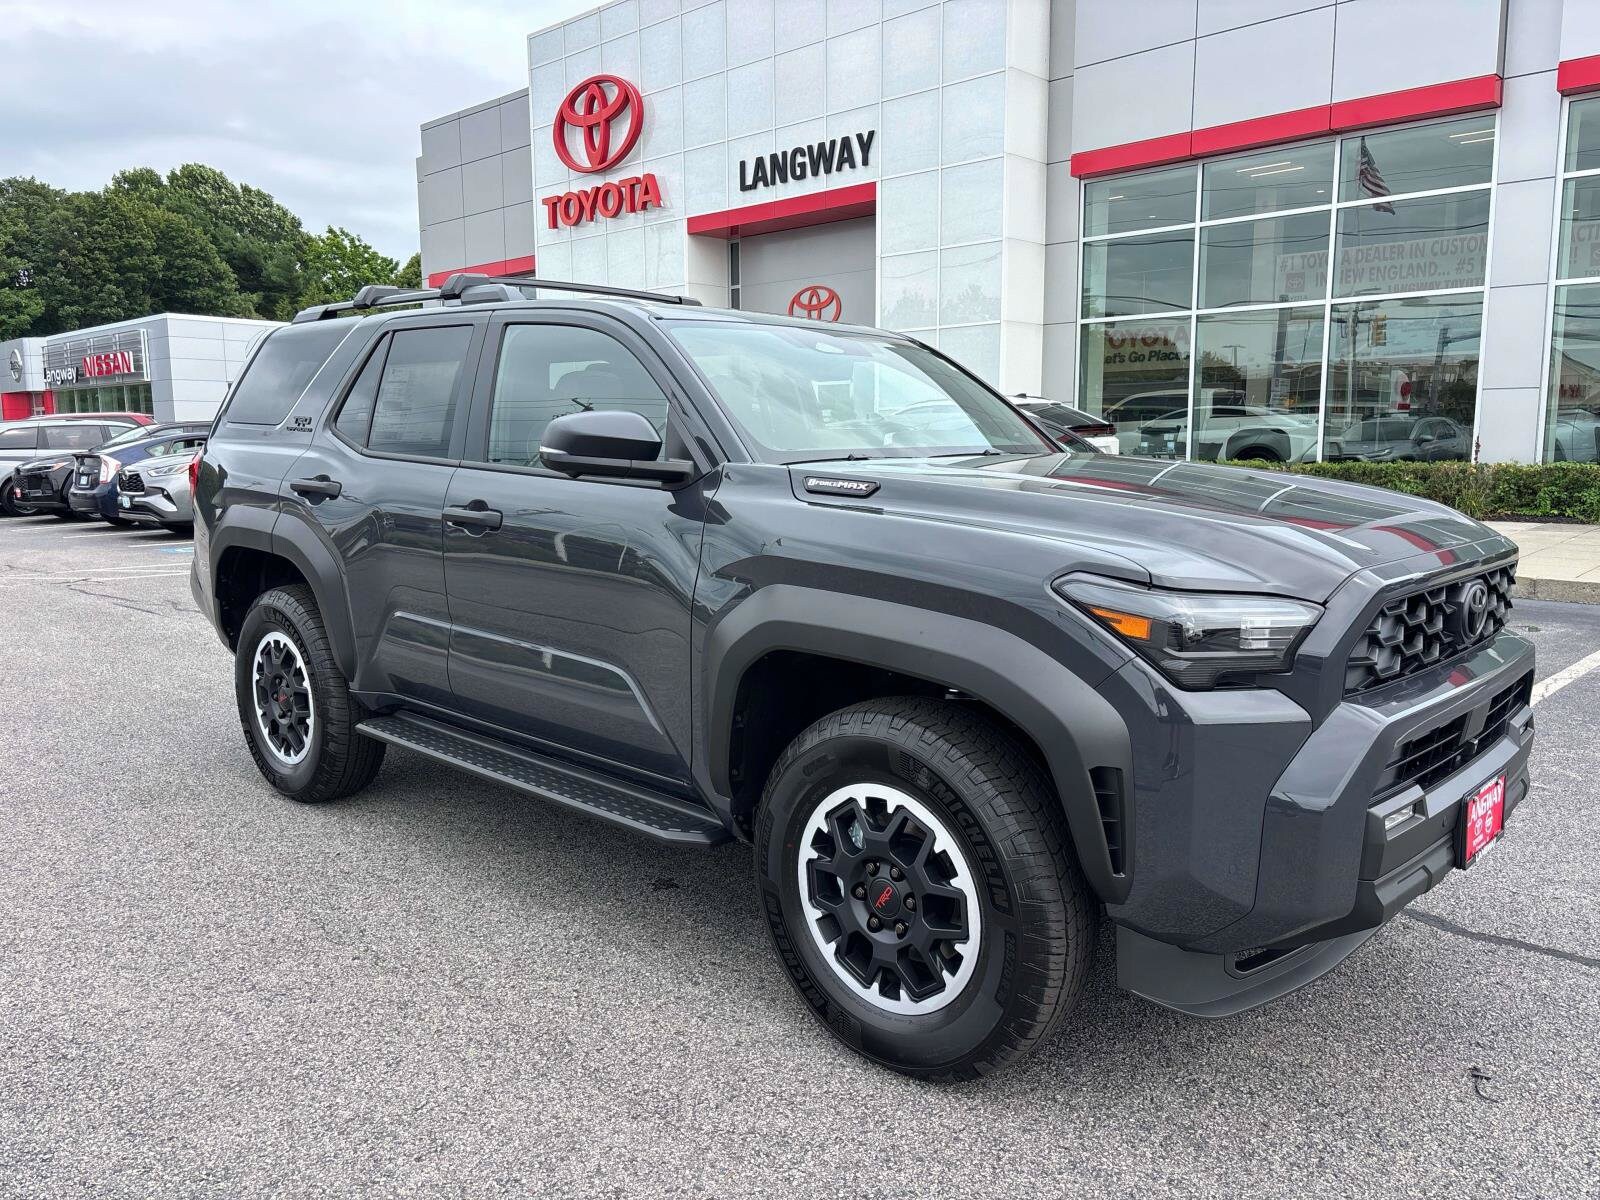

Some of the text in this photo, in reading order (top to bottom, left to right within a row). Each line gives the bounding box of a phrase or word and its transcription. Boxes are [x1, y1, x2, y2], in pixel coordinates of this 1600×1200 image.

[739, 130, 876, 192] LANGWAY
[542, 173, 663, 230] TOYOTA
[1353, 243, 1405, 265] DEALER
[1409, 241, 1426, 259] IN
[1455, 256, 1475, 274] #5
[1104, 326, 1189, 350] OYOTA
[43, 351, 134, 385] Langway NISSAN
[1129, 350, 1146, 362] Go
[1467, 779, 1504, 828] LANGWAY
[875, 886, 893, 908] TRD
